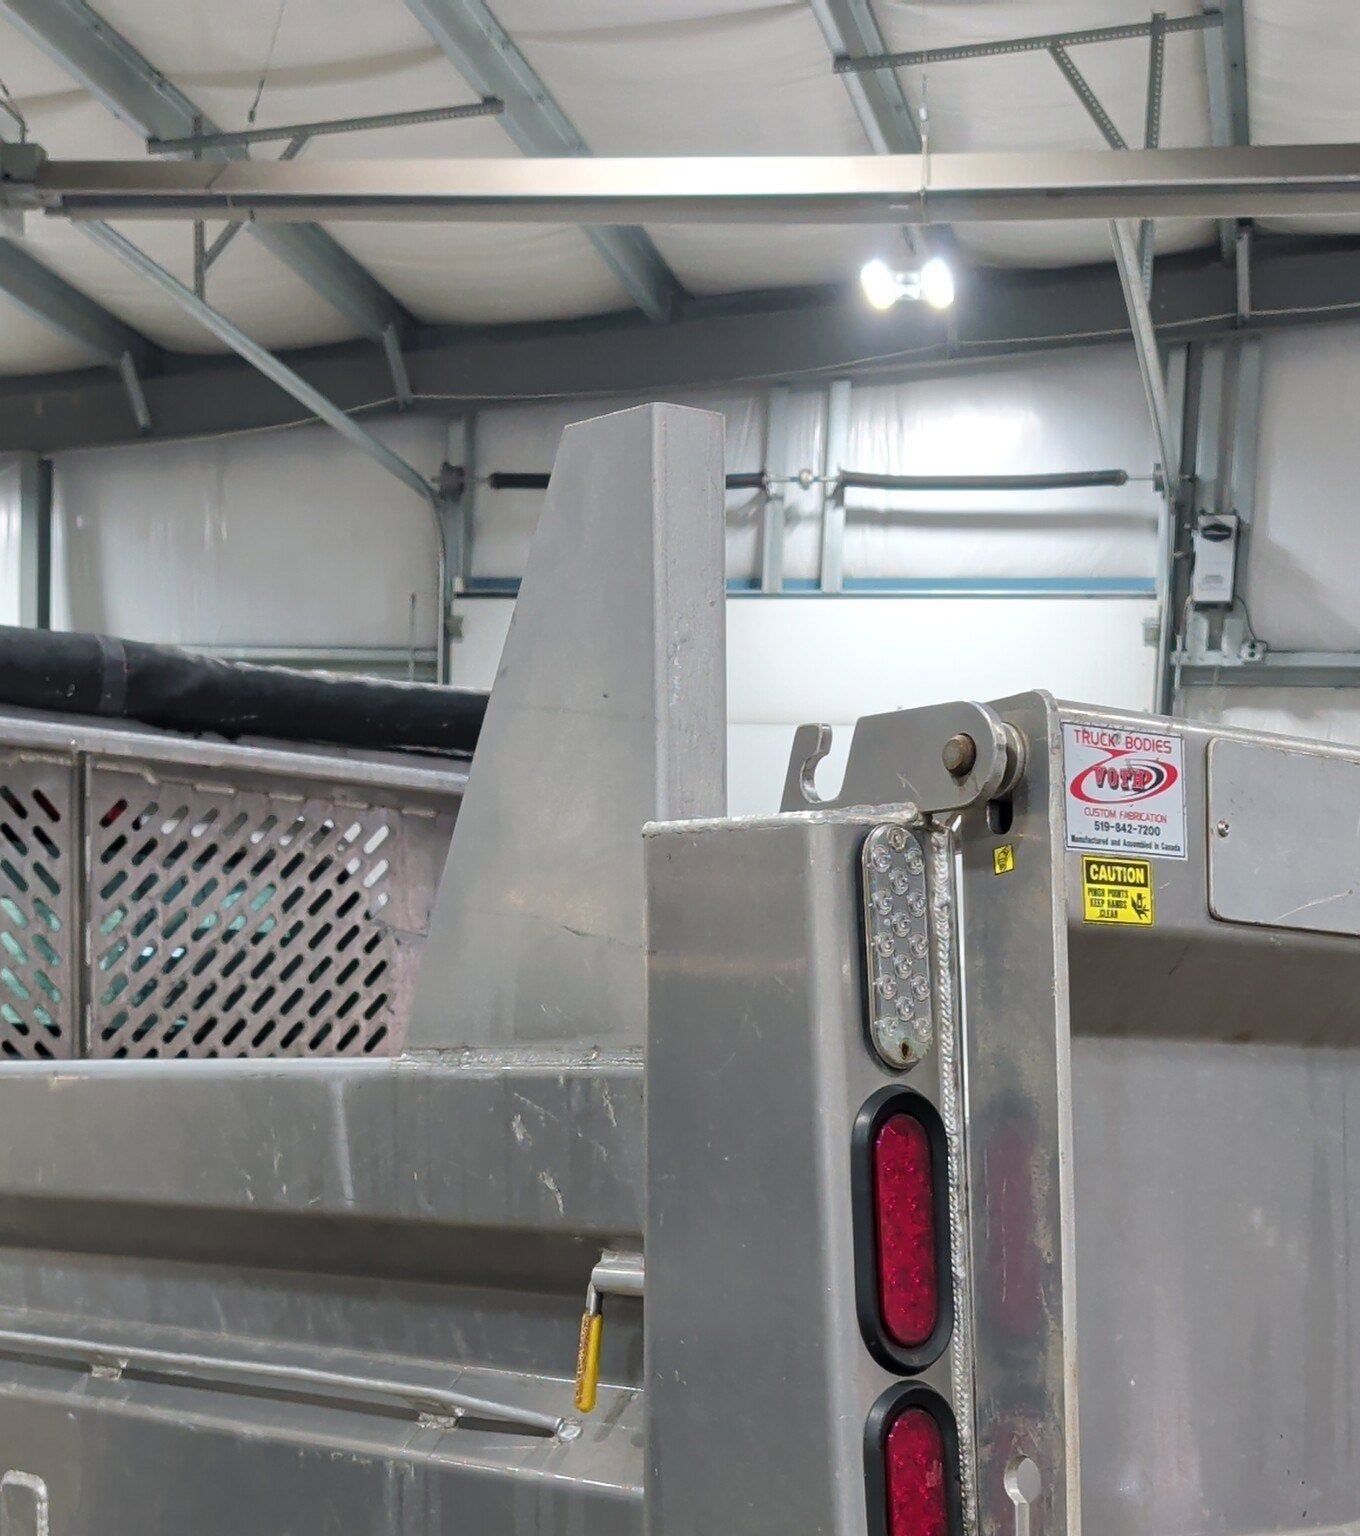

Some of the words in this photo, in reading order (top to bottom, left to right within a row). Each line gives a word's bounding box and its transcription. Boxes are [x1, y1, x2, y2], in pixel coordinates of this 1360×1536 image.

[1074, 729, 1116, 747] TRUCK
[1125, 736, 1172, 754] BODIES
[1093, 766, 1147, 791] VOTH
[1084, 807, 1116, 819] CUSTOM
[1120, 810, 1167, 823] FABRICATION
[1094, 821, 1161, 836] 519-842-7200
[1071, 834, 1108, 845] Manufactured
[1111, 838, 1120, 846] and
[1161, 842, 1180, 852] Canada
[1090, 864, 1145, 884] CAUTION
[1090, 898, 1105, 908] KEEP
